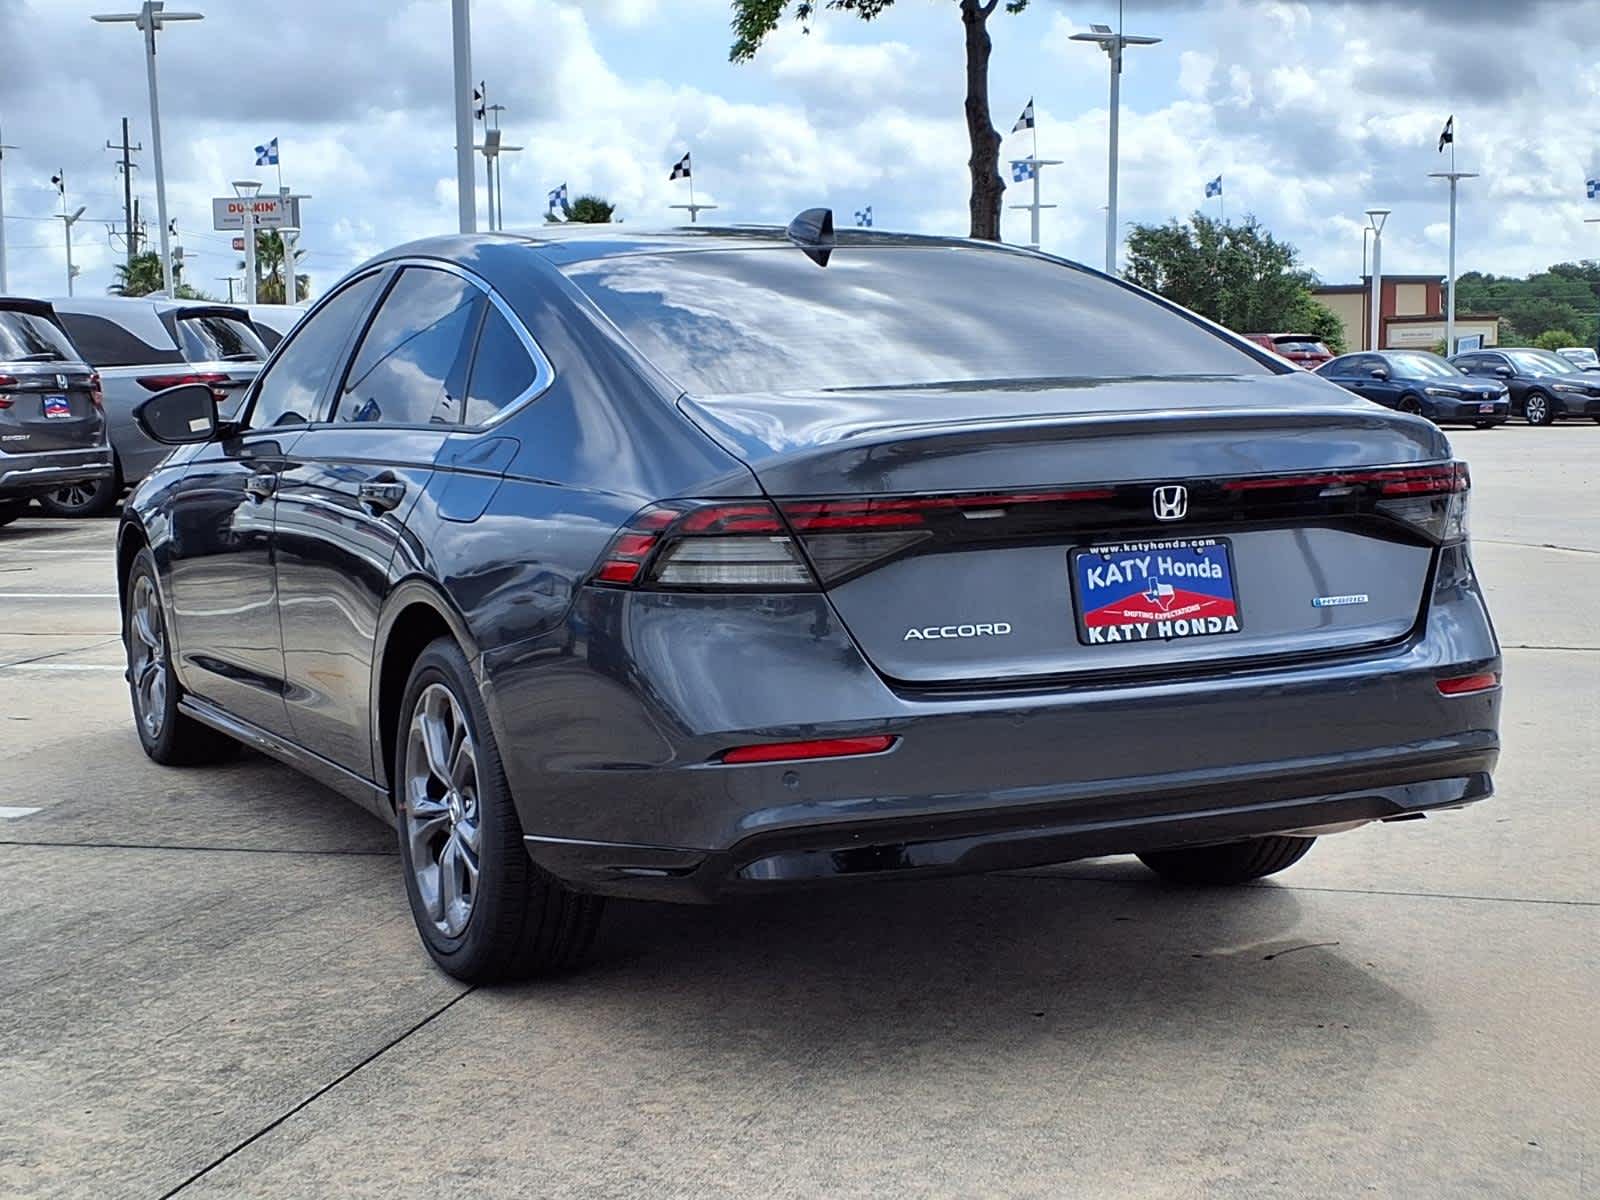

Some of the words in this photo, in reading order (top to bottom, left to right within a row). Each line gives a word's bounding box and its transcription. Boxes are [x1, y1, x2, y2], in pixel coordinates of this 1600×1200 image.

[228, 202, 277, 213] DUKIN'
[1089, 538, 1216, 554] www.katyhonda.com
[1087, 555, 1151, 590] KATY
[1157, 556, 1223, 579] Honda
[904, 622, 1012, 641] ACCORD
[1088, 622, 1150, 644] KATY
[1157, 615, 1239, 638] HONDA
